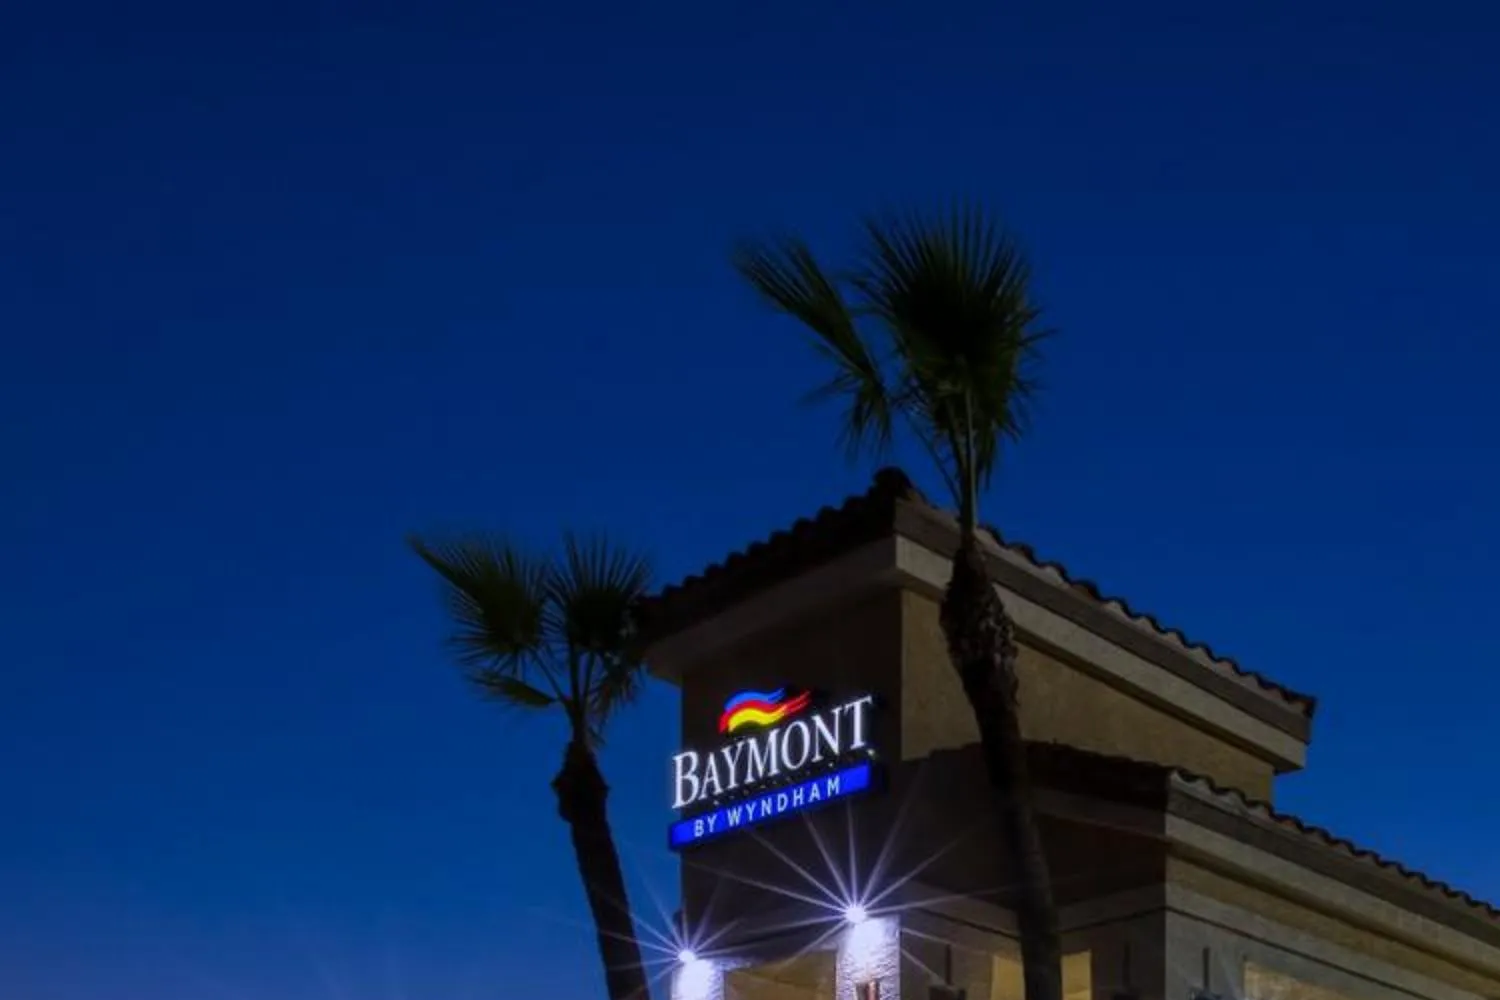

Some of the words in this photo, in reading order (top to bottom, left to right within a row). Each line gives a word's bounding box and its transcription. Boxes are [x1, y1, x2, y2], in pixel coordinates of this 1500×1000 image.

[672, 696, 872, 809] BAYMONT
[694, 815, 718, 837] BY
[727, 775, 841, 827] WYNDHAM
